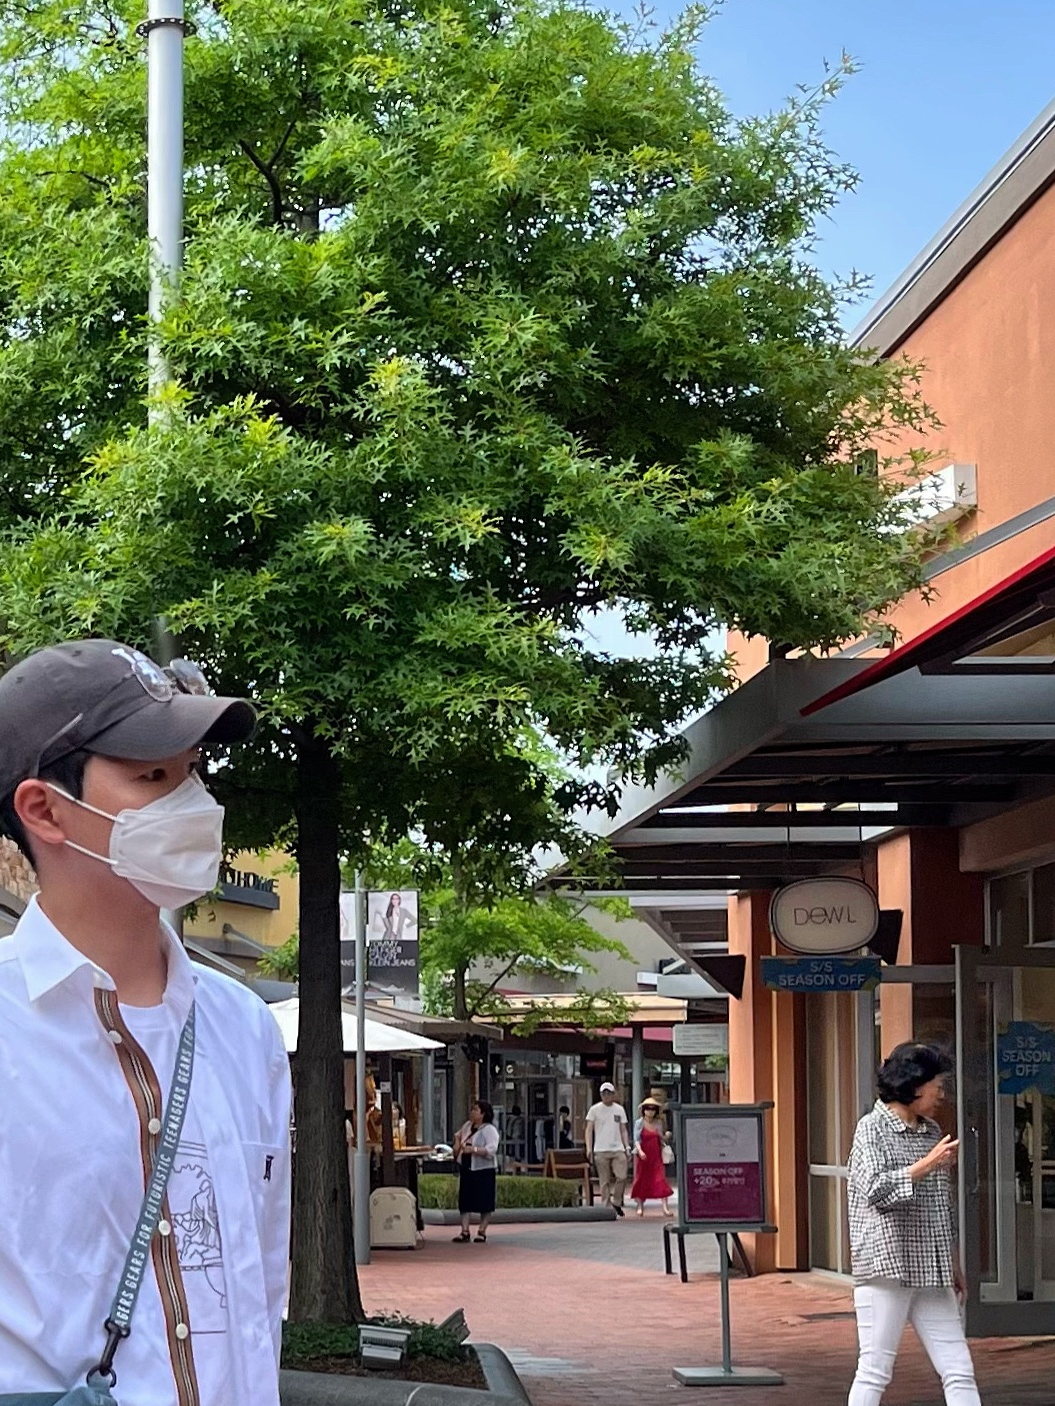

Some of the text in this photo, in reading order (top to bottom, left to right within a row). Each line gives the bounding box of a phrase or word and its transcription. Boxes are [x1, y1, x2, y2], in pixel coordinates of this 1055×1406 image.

[810, 961, 833, 972] S/S
[778, 974, 865, 986] SEASON OFF
[176, 1048, 193, 1084] GEARS
[1002, 1050, 1052, 1062] SEASON
[1016, 1064, 1039, 1076] OFF
[163, 1085, 187, 1150] TEENAGERS
[693, 1168, 726, 1176] SEASON
[144, 1153, 171, 1222] FUTURISTIC
[136, 1223, 153, 1248] FOR
[126, 1250, 146, 1288] GEARS
[113, 1290, 135, 1328] AGERS
